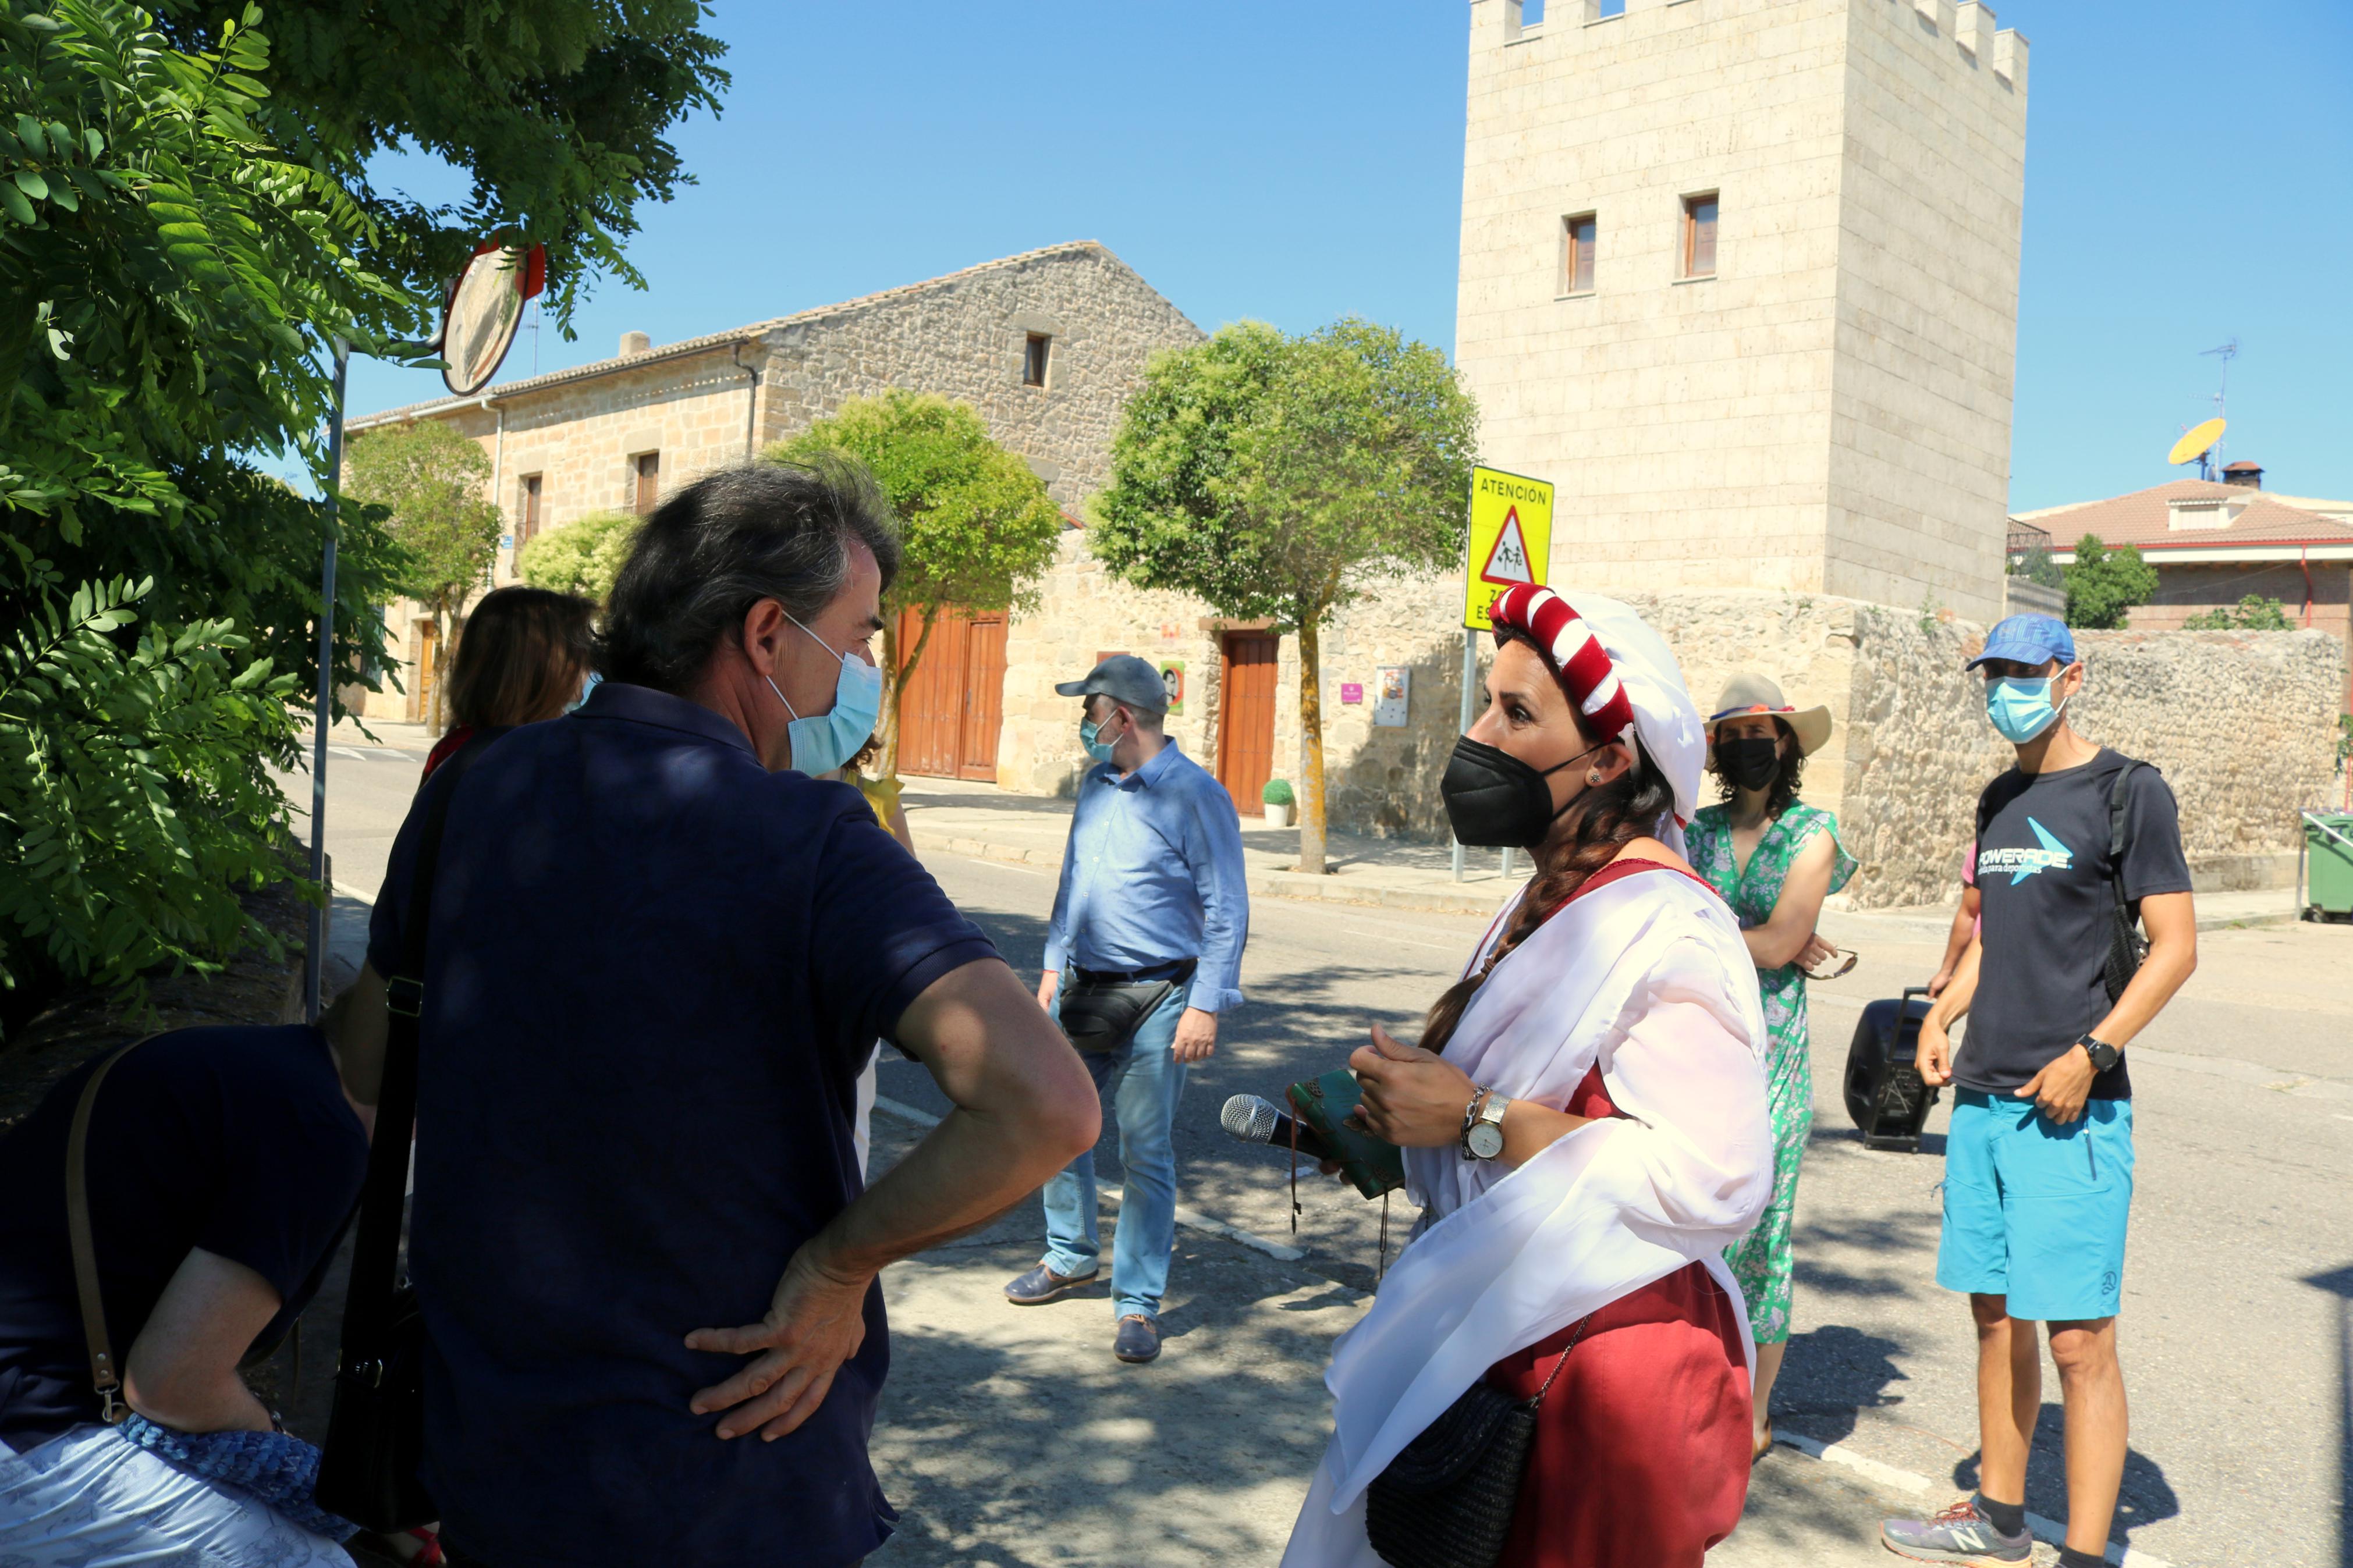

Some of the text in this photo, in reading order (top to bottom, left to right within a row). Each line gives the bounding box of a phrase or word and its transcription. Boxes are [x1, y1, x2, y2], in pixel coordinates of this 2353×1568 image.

[1481, 478, 1546, 505] ATENCIÓN
[1490, 589, 1503, 603] Z
[1979, 848, 2070, 869] POWERADE
[1950, 1527, 1986, 1551] N
